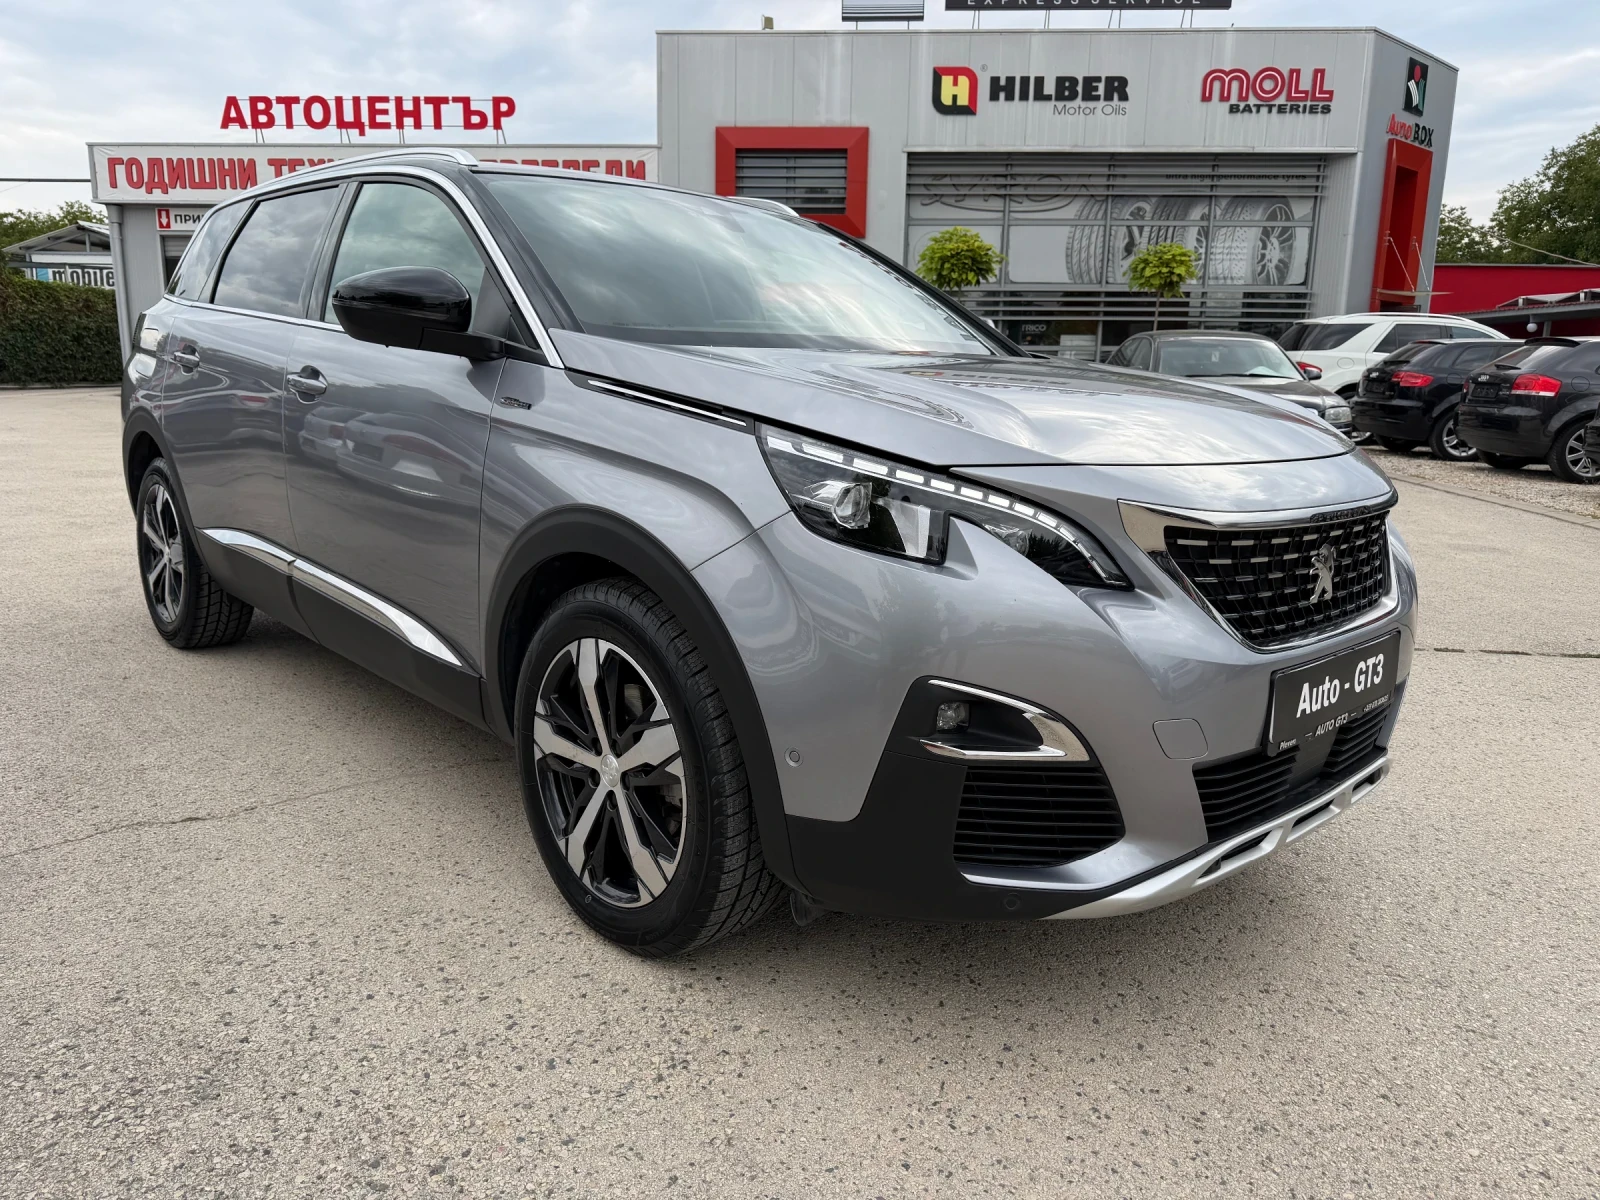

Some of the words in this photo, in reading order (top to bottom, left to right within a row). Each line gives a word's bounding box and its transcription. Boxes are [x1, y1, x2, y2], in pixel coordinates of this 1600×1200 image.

[990, 76, 1129, 102] HILBER
[221, 95, 516, 136] АВТОЦЕНТЪР
[1053, 103, 1097, 116] Motor
[1101, 103, 1127, 116] Oils
[1229, 103, 1332, 115] BATTERIES
[107, 157, 257, 194] ГОДИШНИ
[174, 213, 204, 224] ПРИ
[1296, 676, 1340, 718] Auto
[1354, 653, 1384, 693] GT3
[1315, 719, 1335, 737] AUTO
[1335, 713, 1349, 727] GT3
